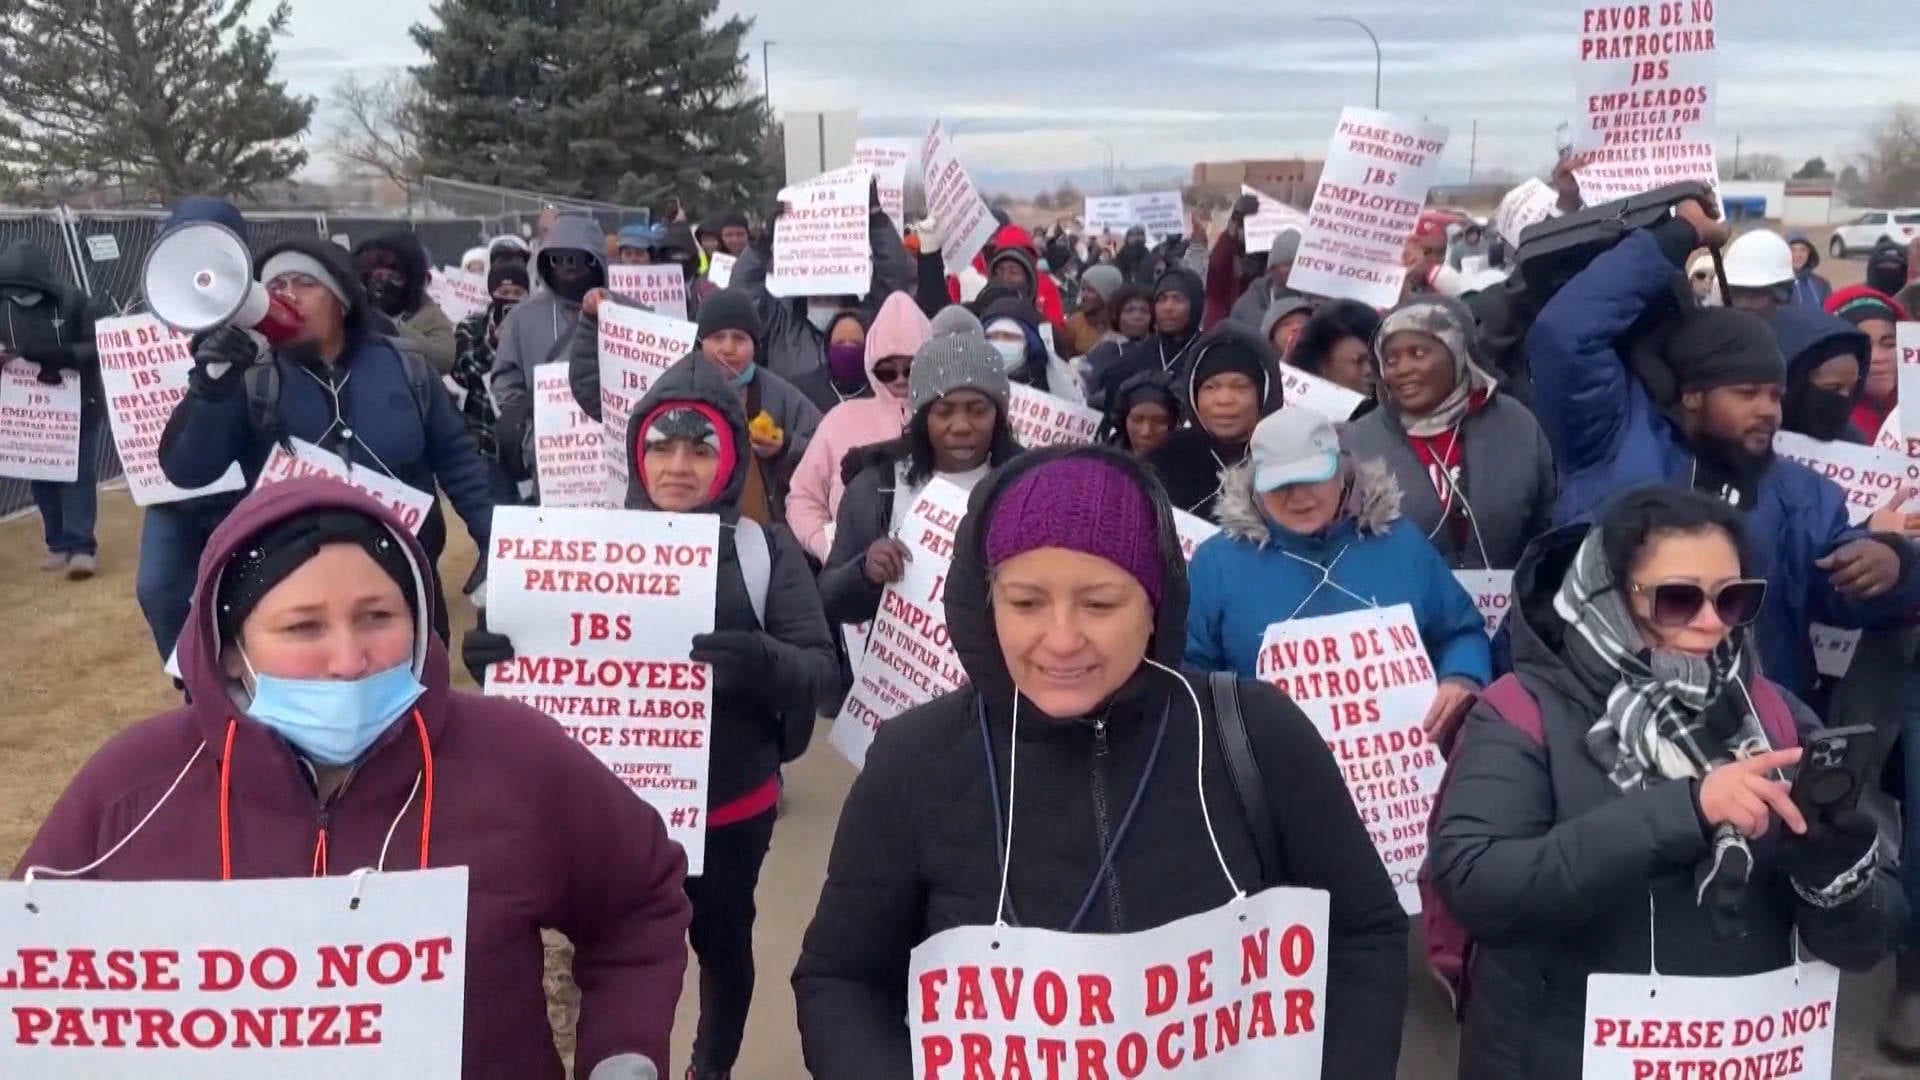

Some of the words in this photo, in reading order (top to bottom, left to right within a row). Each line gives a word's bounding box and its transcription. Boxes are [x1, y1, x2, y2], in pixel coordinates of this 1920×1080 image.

[1583, 5, 1650, 33] FAVOR
[1660, 2, 1683, 26] DE
[1691, 0, 1713, 23] NO
[1582, 29, 1714, 60] PRATROCINAR
[1631, 60, 1669, 86] JBS
[1589, 85, 1707, 113] EMPLEADOS
[1592, 115, 1608, 130] EN
[1614, 110, 1667, 127] HUELGA
[1672, 107, 1700, 122] POR
[1340, 123, 1389, 142] PLEASE
[1393, 134, 1413, 147] DO
[1417, 140, 1444, 154] NOT
[1604, 127, 1682, 145] PRACTICAS
[1350, 140, 1425, 167] PATRONIZE
[1652, 144, 1711, 160] INJUSTAS
[1363, 167, 1397, 186] JBS
[1595, 166, 1649, 178] TENEMOS
[1654, 161, 1712, 175] DISPUTAS
[811, 191, 836, 203] JBS
[1319, 183, 1419, 216] EMPLOYEES
[784, 205, 866, 220] MPLOYEES
[1314, 203, 1332, 214] ON
[1335, 207, 1378, 224] UNFAIR
[1381, 218, 1414, 231] LABOR
[1310, 217, 1369, 239] PRACTICE
[1372, 231, 1403, 245] STRIK
[612, 274, 640, 287] AVOR
[648, 274, 661, 287] DE
[667, 273, 681, 285] NO
[812, 265, 851, 275] LOCAL
[1298, 255, 1335, 272] UFCW
[1339, 264, 1381, 283] LOCAL
[137, 325, 161, 345] DE
[600, 321, 633, 341] LEASE
[637, 331, 656, 346] DO
[659, 339, 689, 354] NOT
[604, 340, 671, 369] PATRONIZE
[132, 370, 161, 389] JBS
[622, 370, 648, 390] JBS
[1285, 375, 1311, 395] BS
[28, 394, 50, 405] JBS
[1010, 397, 1049, 421] AVOR
[2, 408, 78, 421] EMPLOYEES
[136, 406, 173, 420] HUELG
[118, 437, 159, 450] LABORAL
[539, 433, 605, 449] EMPLOY
[542, 465, 596, 476] PRACTICE
[1825, 463, 1855, 482] DO
[1860, 471, 1902, 490] NOT
[914, 500, 959, 532] PLEA
[496, 538, 597, 562] PLEASE
[605, 543, 645, 564] DO
[654, 545, 712, 567] NOT
[524, 569, 681, 596] PATRONIZE
[1478, 594, 1507, 608] NO
[570, 612, 632, 646] JBS
[883, 589, 951, 647] EMPLO
[878, 619, 895, 639] ON
[897, 632, 940, 672] UNFAIR
[1259, 637, 1341, 674] FAVOR
[1350, 628, 1384, 660] DE
[1388, 624, 1417, 651] NO
[493, 657, 706, 692] EMPLOYEES
[871, 640, 930, 692] PRACTICE
[535, 695, 620, 717] UNFAIR
[629, 700, 706, 719] LABOR
[1330, 698, 1381, 732] JBS
[620, 728, 704, 748] STRIKE
[613, 763, 672, 775] DISPUTE
[1400, 749, 1435, 772] POR
[1356, 776, 1419, 801] CTICAS
[670, 807, 700, 828] #7
[1387, 795, 1434, 820] INJUS
[1392, 821, 1426, 840] DISP
[198, 948, 298, 991] DO
[317, 937, 452, 988] NOT
[919, 966, 1114, 1026] FAVOR
[1145, 949, 1213, 1017] DE
[1241, 924, 1315, 986] NO
[12, 1003, 383, 1048] PATRONIZE
[921, 988, 1316, 1080] PRATROCINAR
[1593, 1018, 1724, 1049] PLEASE
[1732, 1016, 1775, 1046] DO
[1781, 1001, 1831, 1038] NOT
[1632, 1046, 1804, 1080] PATRONIZE
